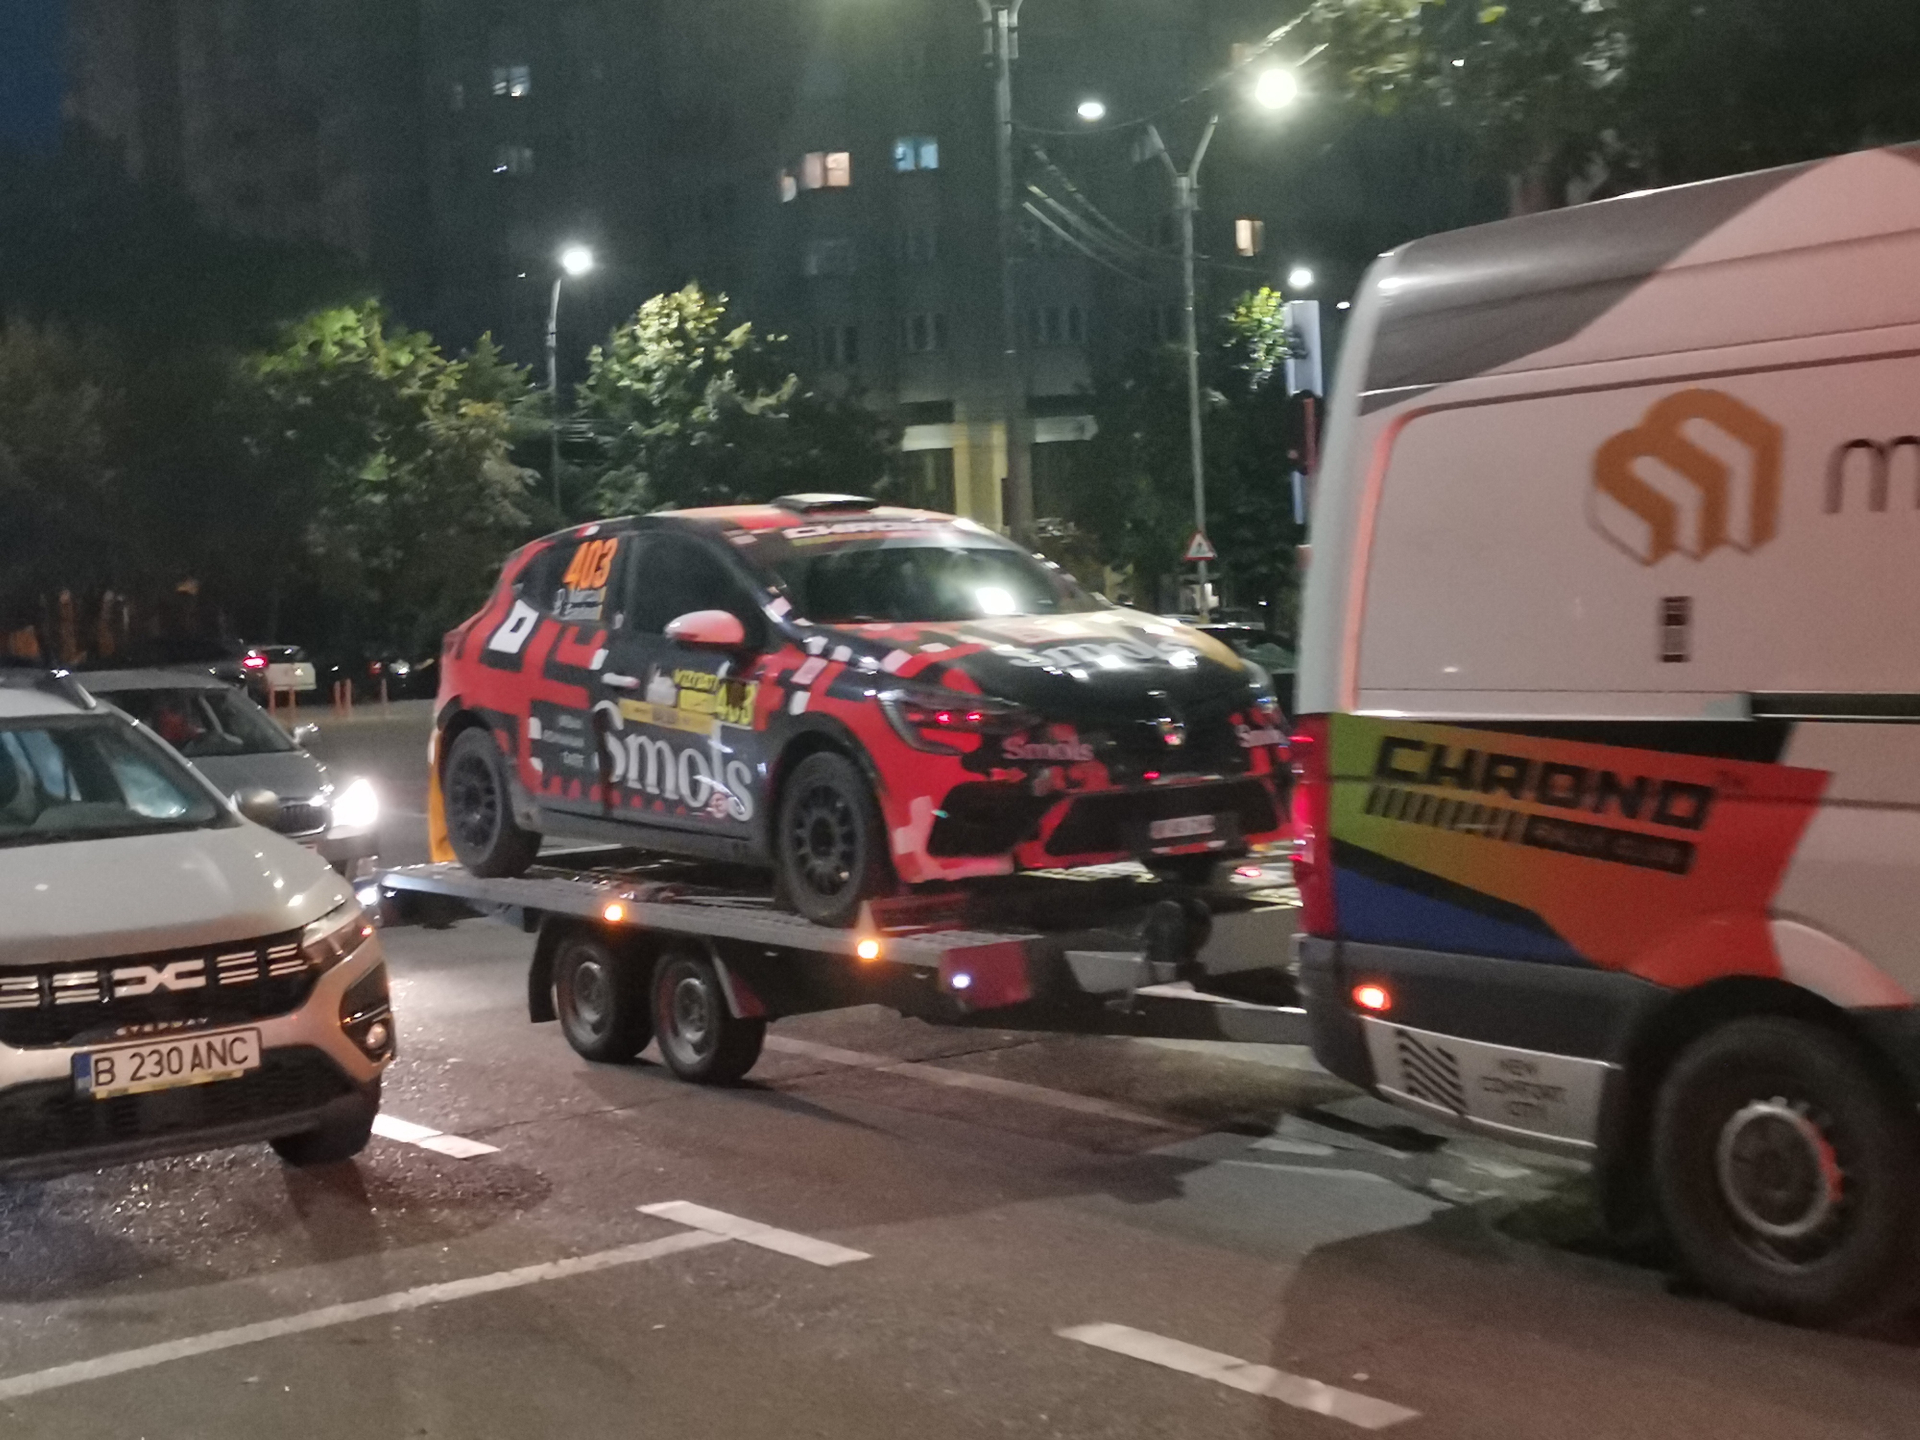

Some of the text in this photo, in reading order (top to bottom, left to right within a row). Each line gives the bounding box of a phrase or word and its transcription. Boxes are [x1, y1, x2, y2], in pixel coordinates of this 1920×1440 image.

[563, 537, 618, 590] 403
[591, 699, 753, 822] Smols
[1374, 735, 1715, 831] CHRONO
[94, 1036, 249, 1087] B 230 ANC
